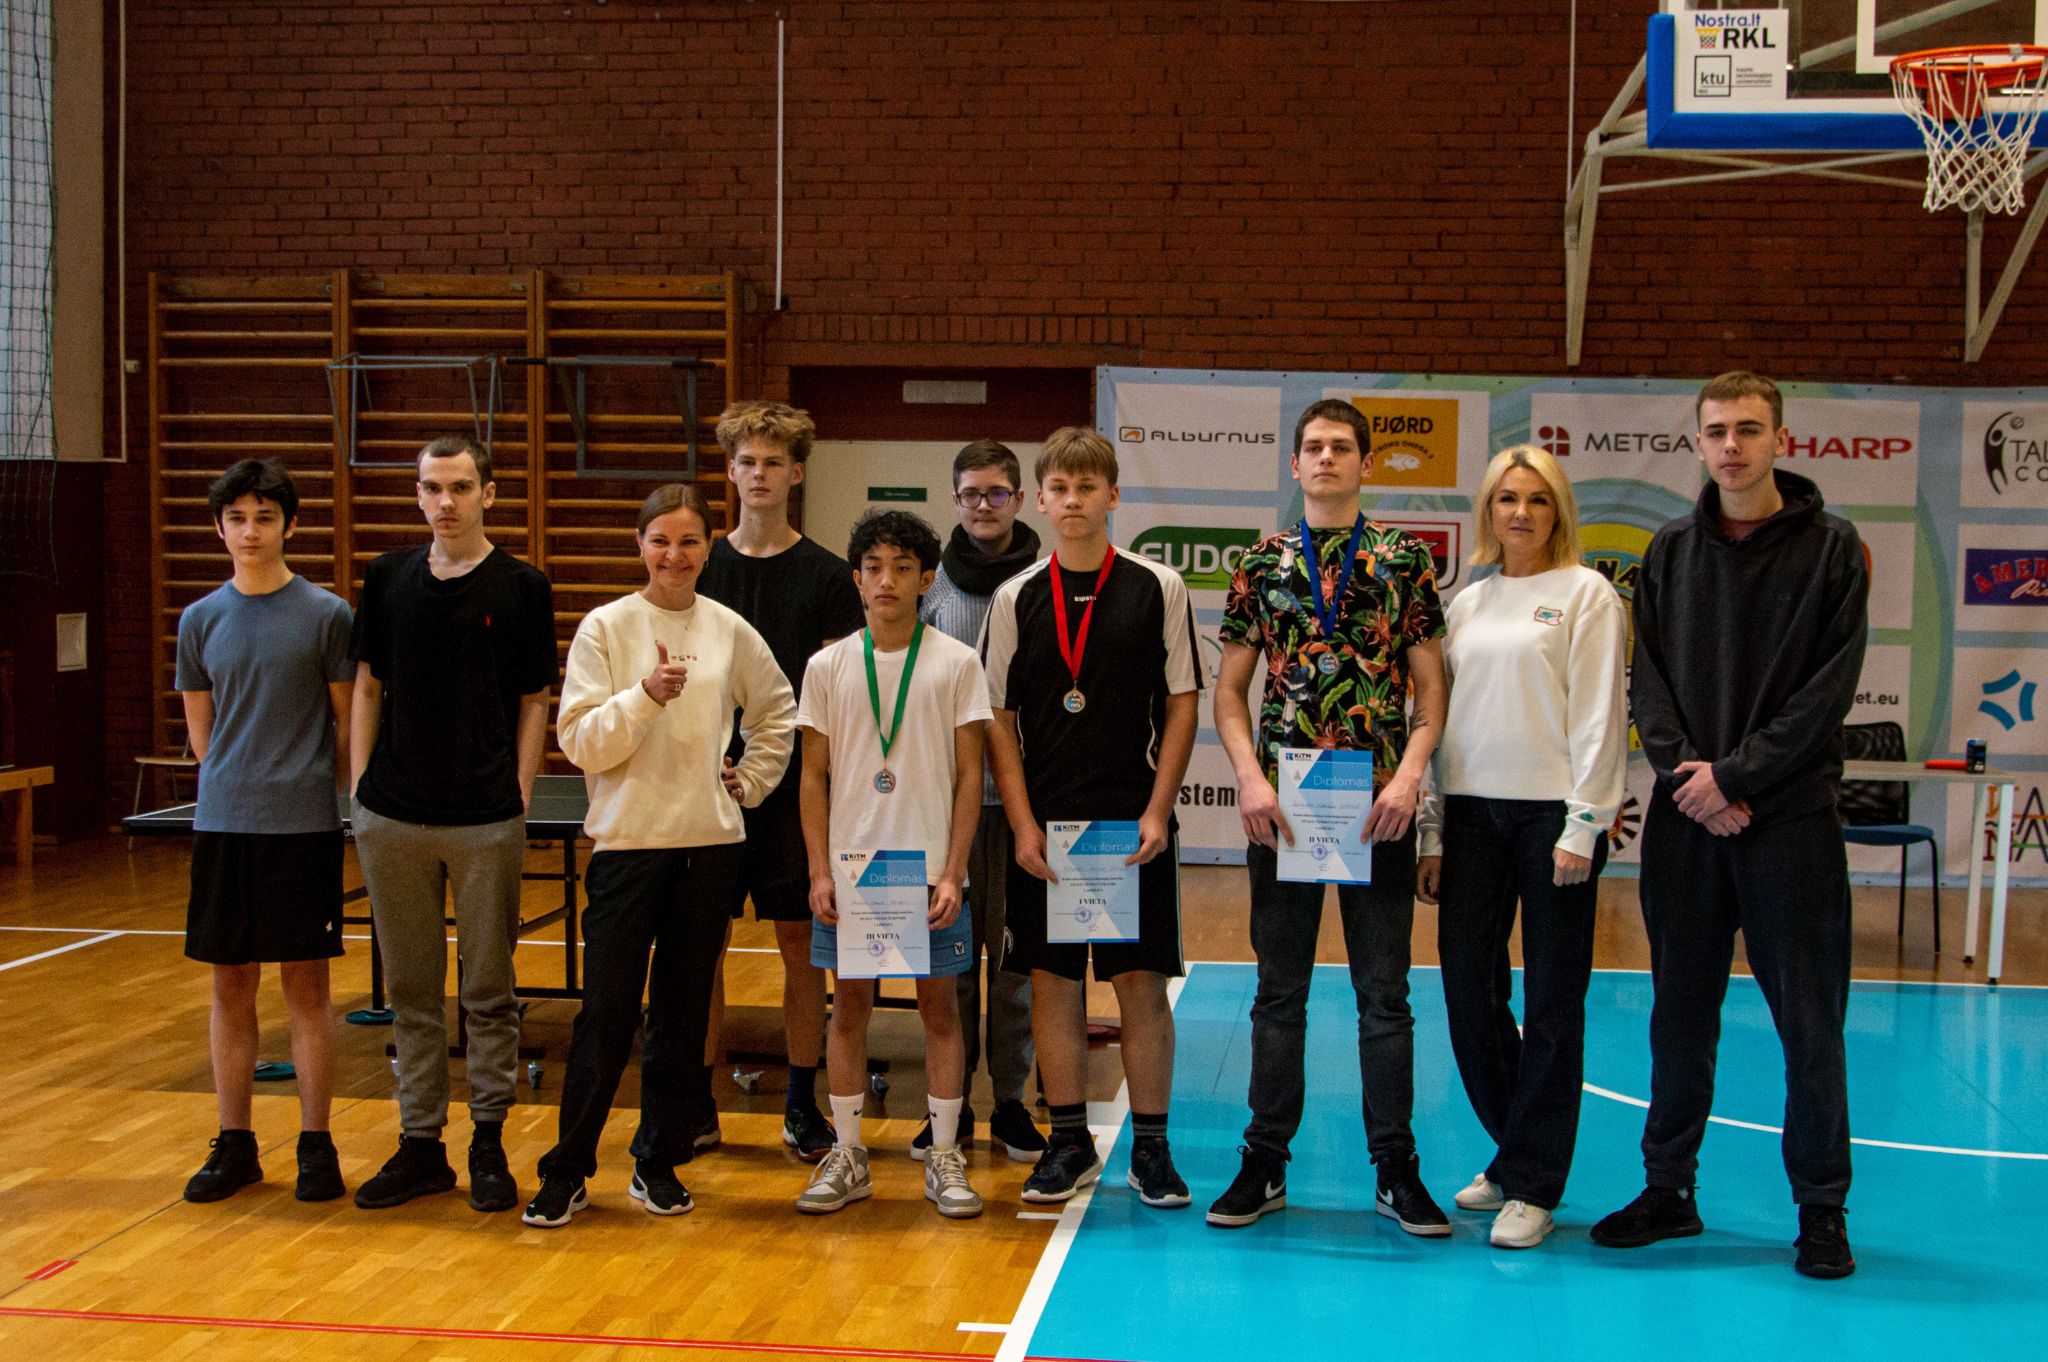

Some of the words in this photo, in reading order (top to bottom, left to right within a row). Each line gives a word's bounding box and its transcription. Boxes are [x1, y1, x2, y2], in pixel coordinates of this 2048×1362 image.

[1695, 14, 1761, 27] Nostra.lt
[1723, 28, 1776, 49] RKL
[1701, 72, 1725, 85] ktu
[1373, 416, 1434, 435] FJØRD
[1584, 433, 1694, 453] METGA
[1787, 436, 1913, 460] HARP
[1855, 692, 1899, 705] et.eu
[1313, 775, 1369, 787] Diplomas
[1180, 784, 1235, 807] stem
[1082, 841, 1136, 853] Diplomas
[869, 872, 924, 884] Diplomas
